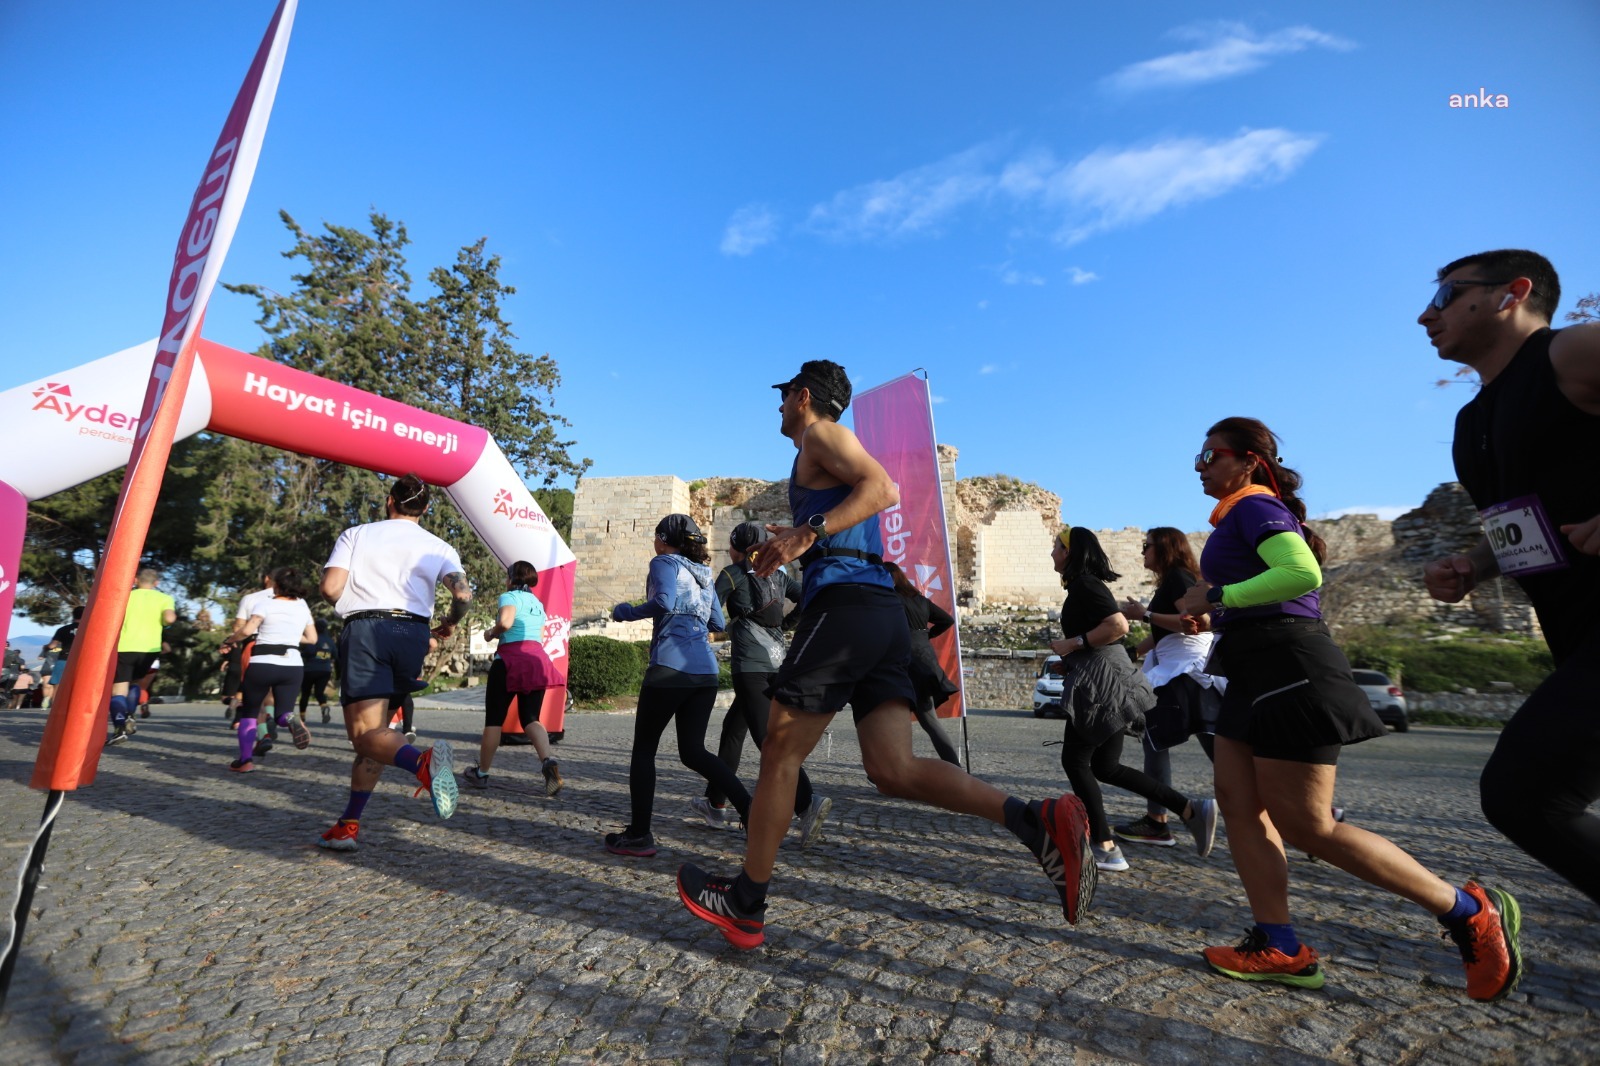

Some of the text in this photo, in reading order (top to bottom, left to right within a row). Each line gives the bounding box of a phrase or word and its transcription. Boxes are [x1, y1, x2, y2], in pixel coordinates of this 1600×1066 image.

[243, 371, 458, 454] Hayat için enerji
[493, 501, 548, 524] Aydem
[1488, 523, 1522, 551] 1190
